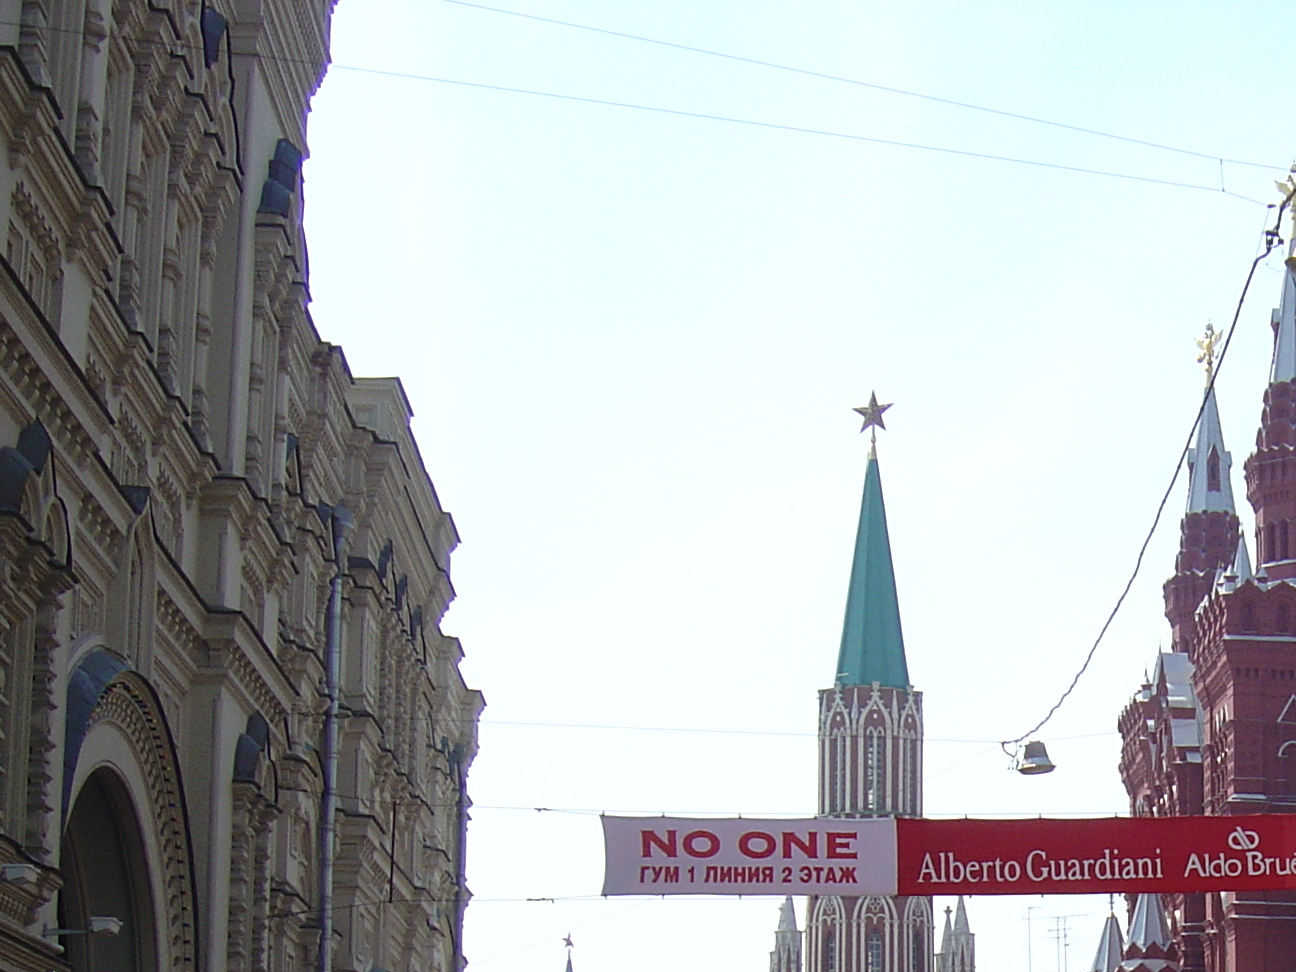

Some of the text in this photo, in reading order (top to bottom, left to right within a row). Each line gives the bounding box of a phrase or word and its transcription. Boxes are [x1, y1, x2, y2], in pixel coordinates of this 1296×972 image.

[640, 830, 859, 860] NO ONE
[639, 866, 859, 884] ГУМ 1 ЛИНИЯ 2 ЭТАЖ
[917, 848, 1164, 884] Alberto Guardiani
